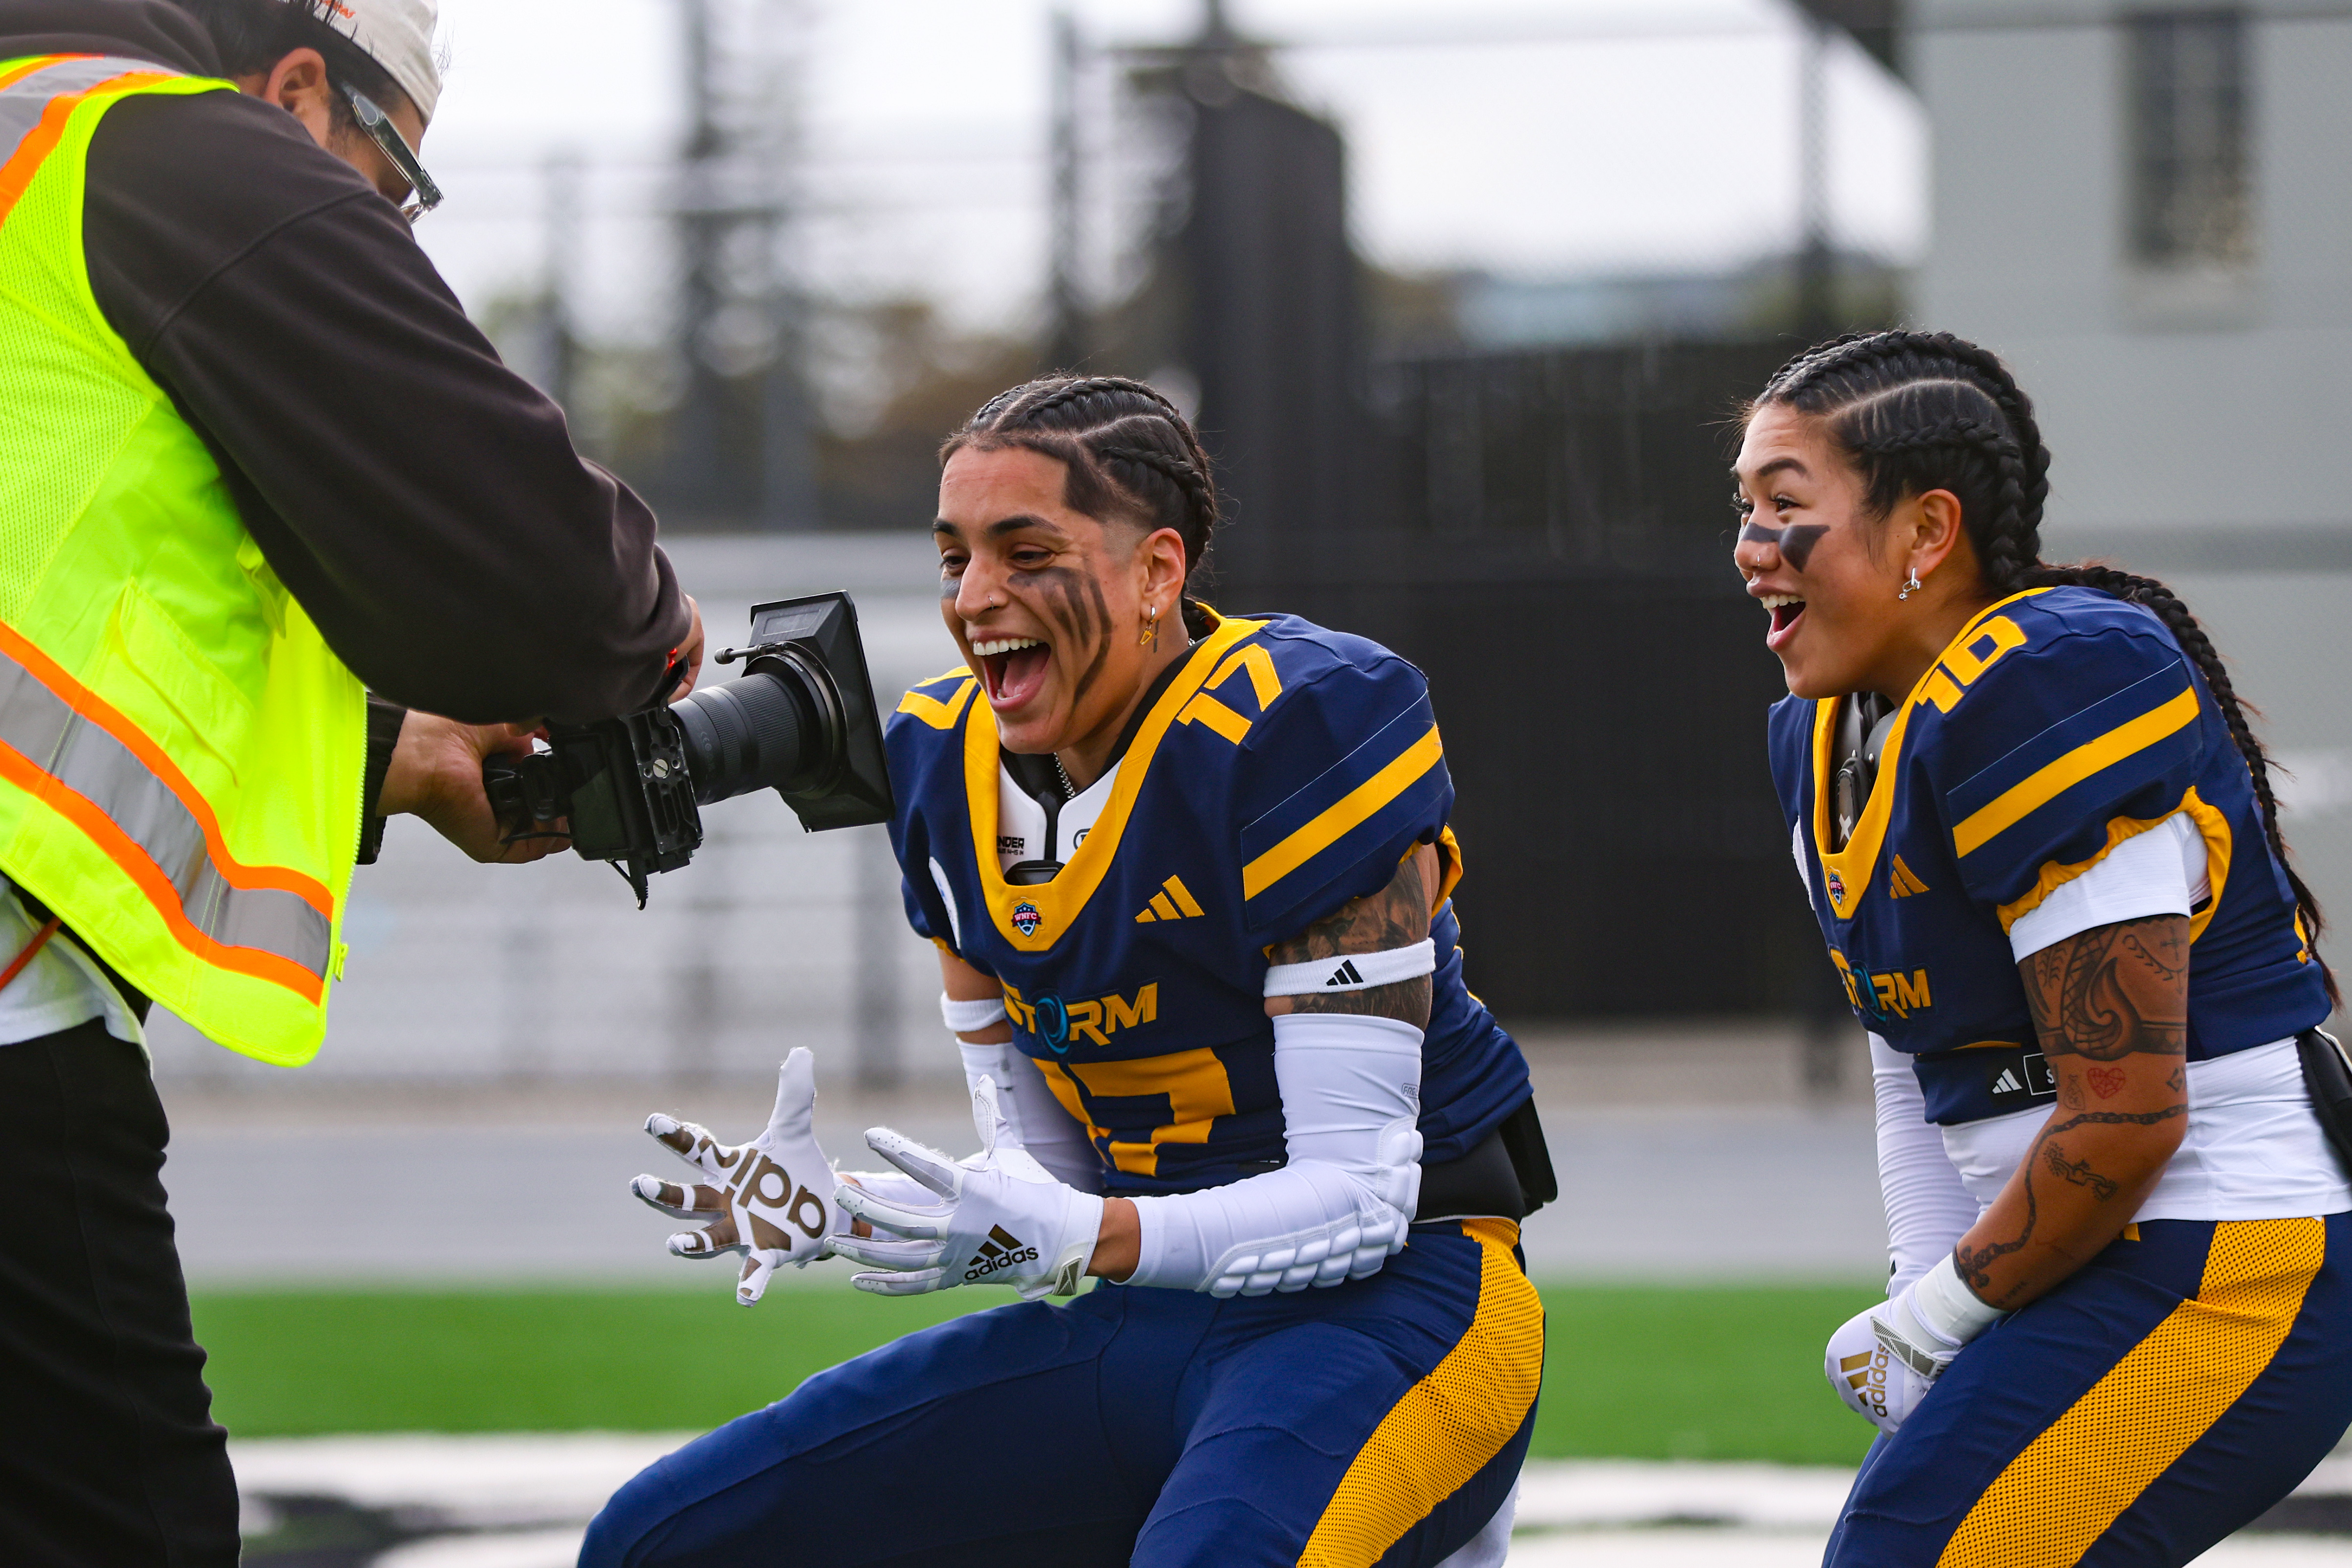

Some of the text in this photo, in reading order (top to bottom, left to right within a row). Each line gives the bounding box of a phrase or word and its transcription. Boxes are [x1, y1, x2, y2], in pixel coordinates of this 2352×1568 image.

[1176, 643, 1283, 746] 17
[1916, 615, 2028, 714] 10
[997, 835, 1025, 849] NDER
[1014, 912, 1037, 921] WNFC
[999, 982, 1158, 1054] STORM
[1031, 1047, 1236, 1176] 17
[964, 1247, 1038, 1280] adidas
[1866, 1343, 1890, 1417] adidas
